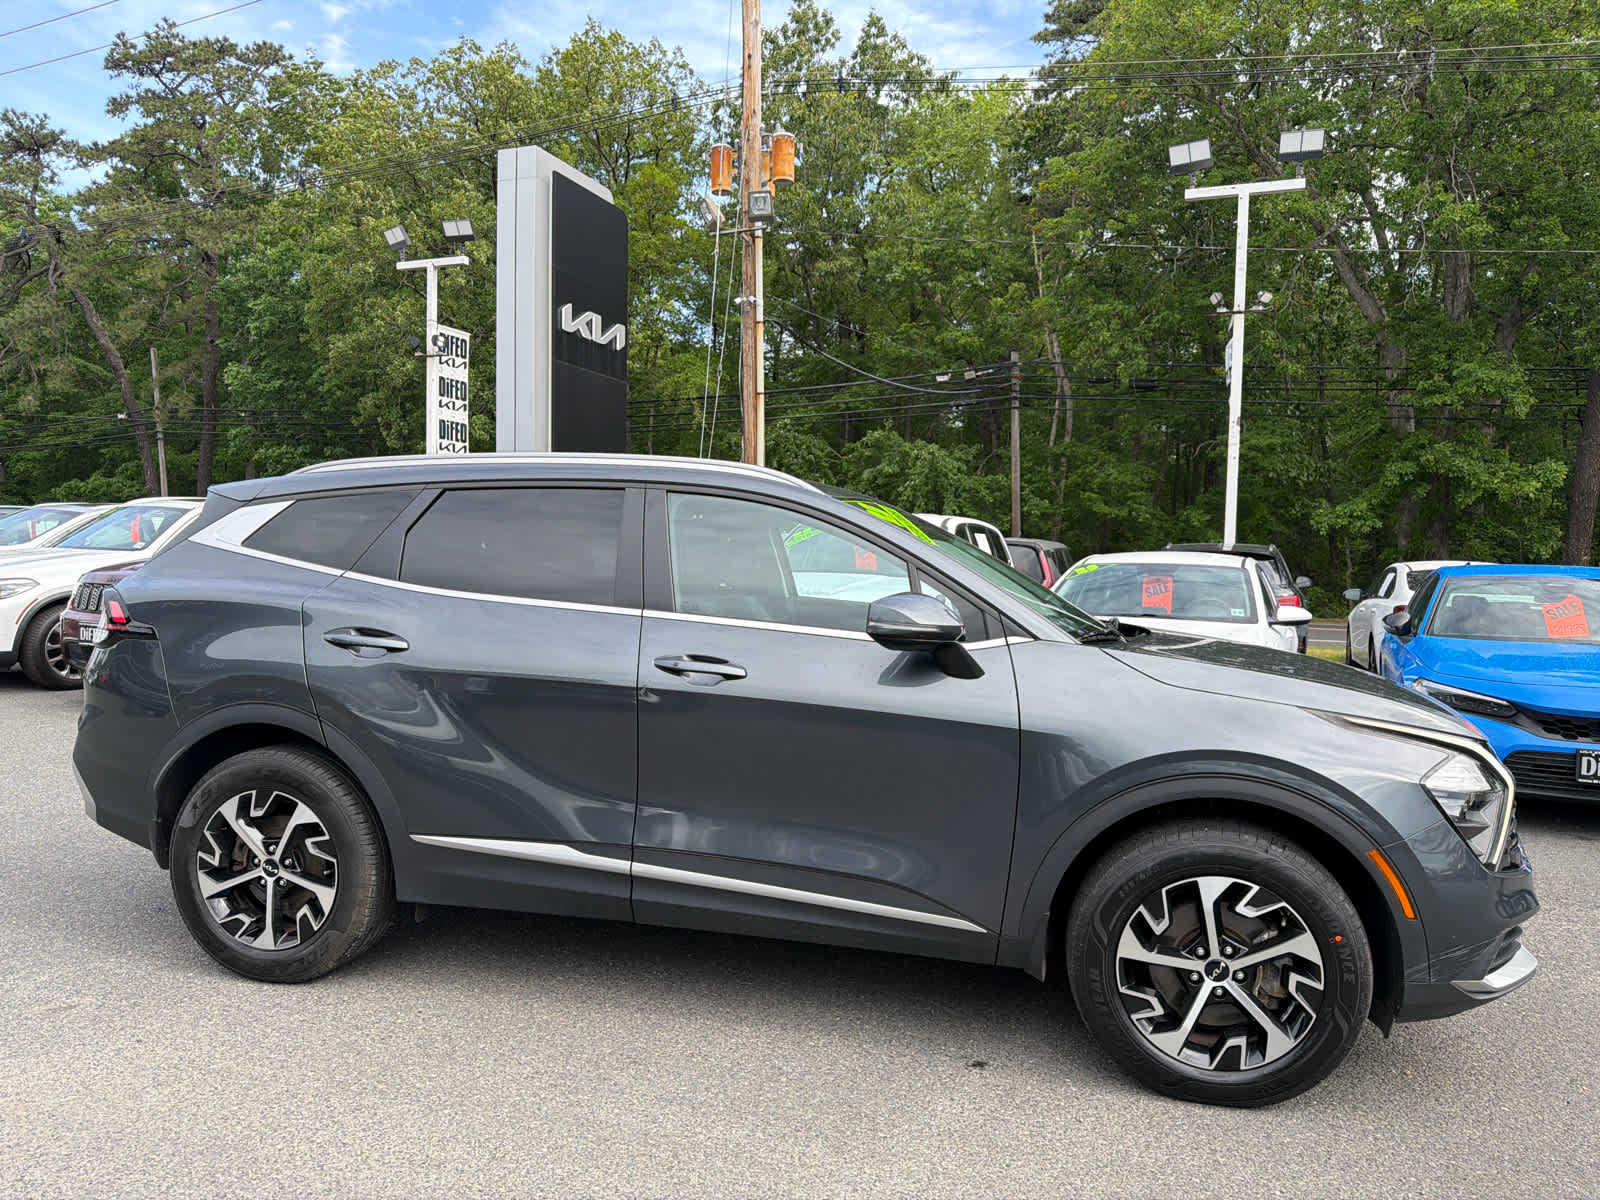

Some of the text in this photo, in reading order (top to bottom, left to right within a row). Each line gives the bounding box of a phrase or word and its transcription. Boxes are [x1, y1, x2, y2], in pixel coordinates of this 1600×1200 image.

[561, 303, 626, 351] KIA
[439, 354, 467, 370] KIA
[439, 399, 467, 412] KIA
[1145, 582, 1170, 599] SALE
[1545, 600, 1581, 620] SALE
